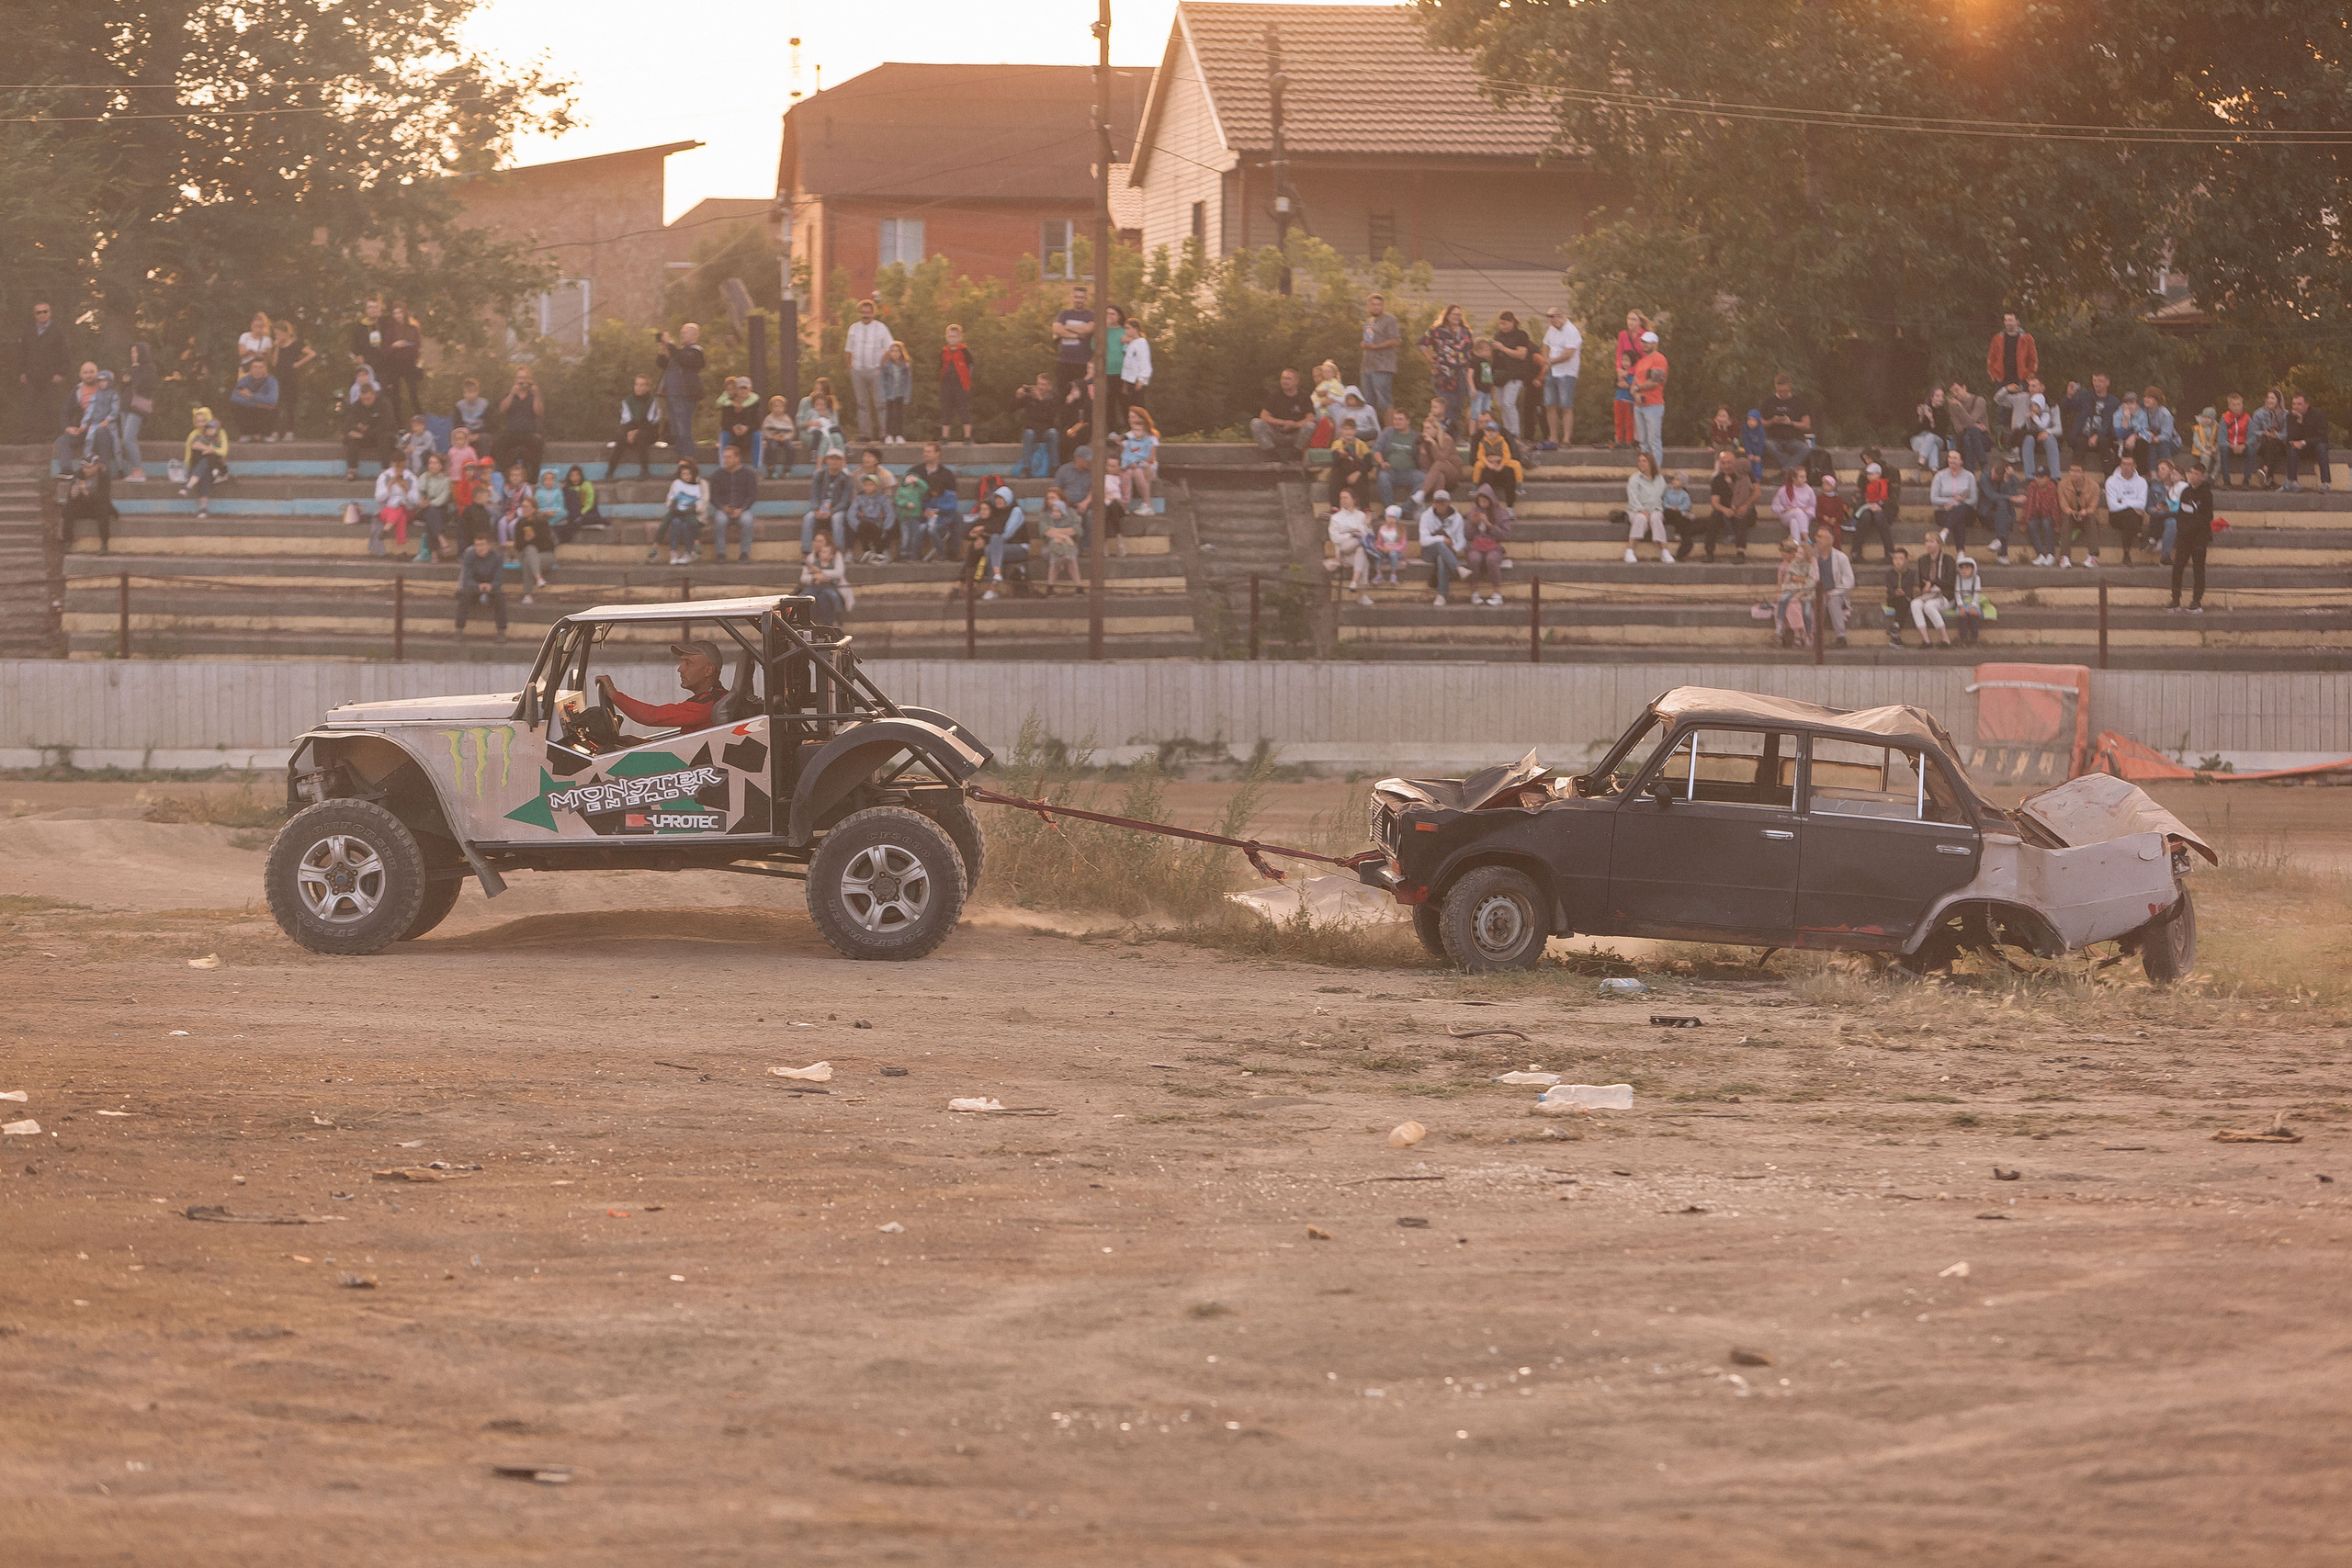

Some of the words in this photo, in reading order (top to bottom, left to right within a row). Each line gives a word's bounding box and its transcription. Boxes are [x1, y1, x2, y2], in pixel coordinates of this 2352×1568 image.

[548, 767, 722, 809] MONSTER
[586, 784, 700, 813] ENERGY
[301, 821, 398, 870] COMFORSER
[866, 830, 931, 858] CF3000
[295, 911, 358, 937] CF3000
[828, 898, 925, 947] COMFORSER
